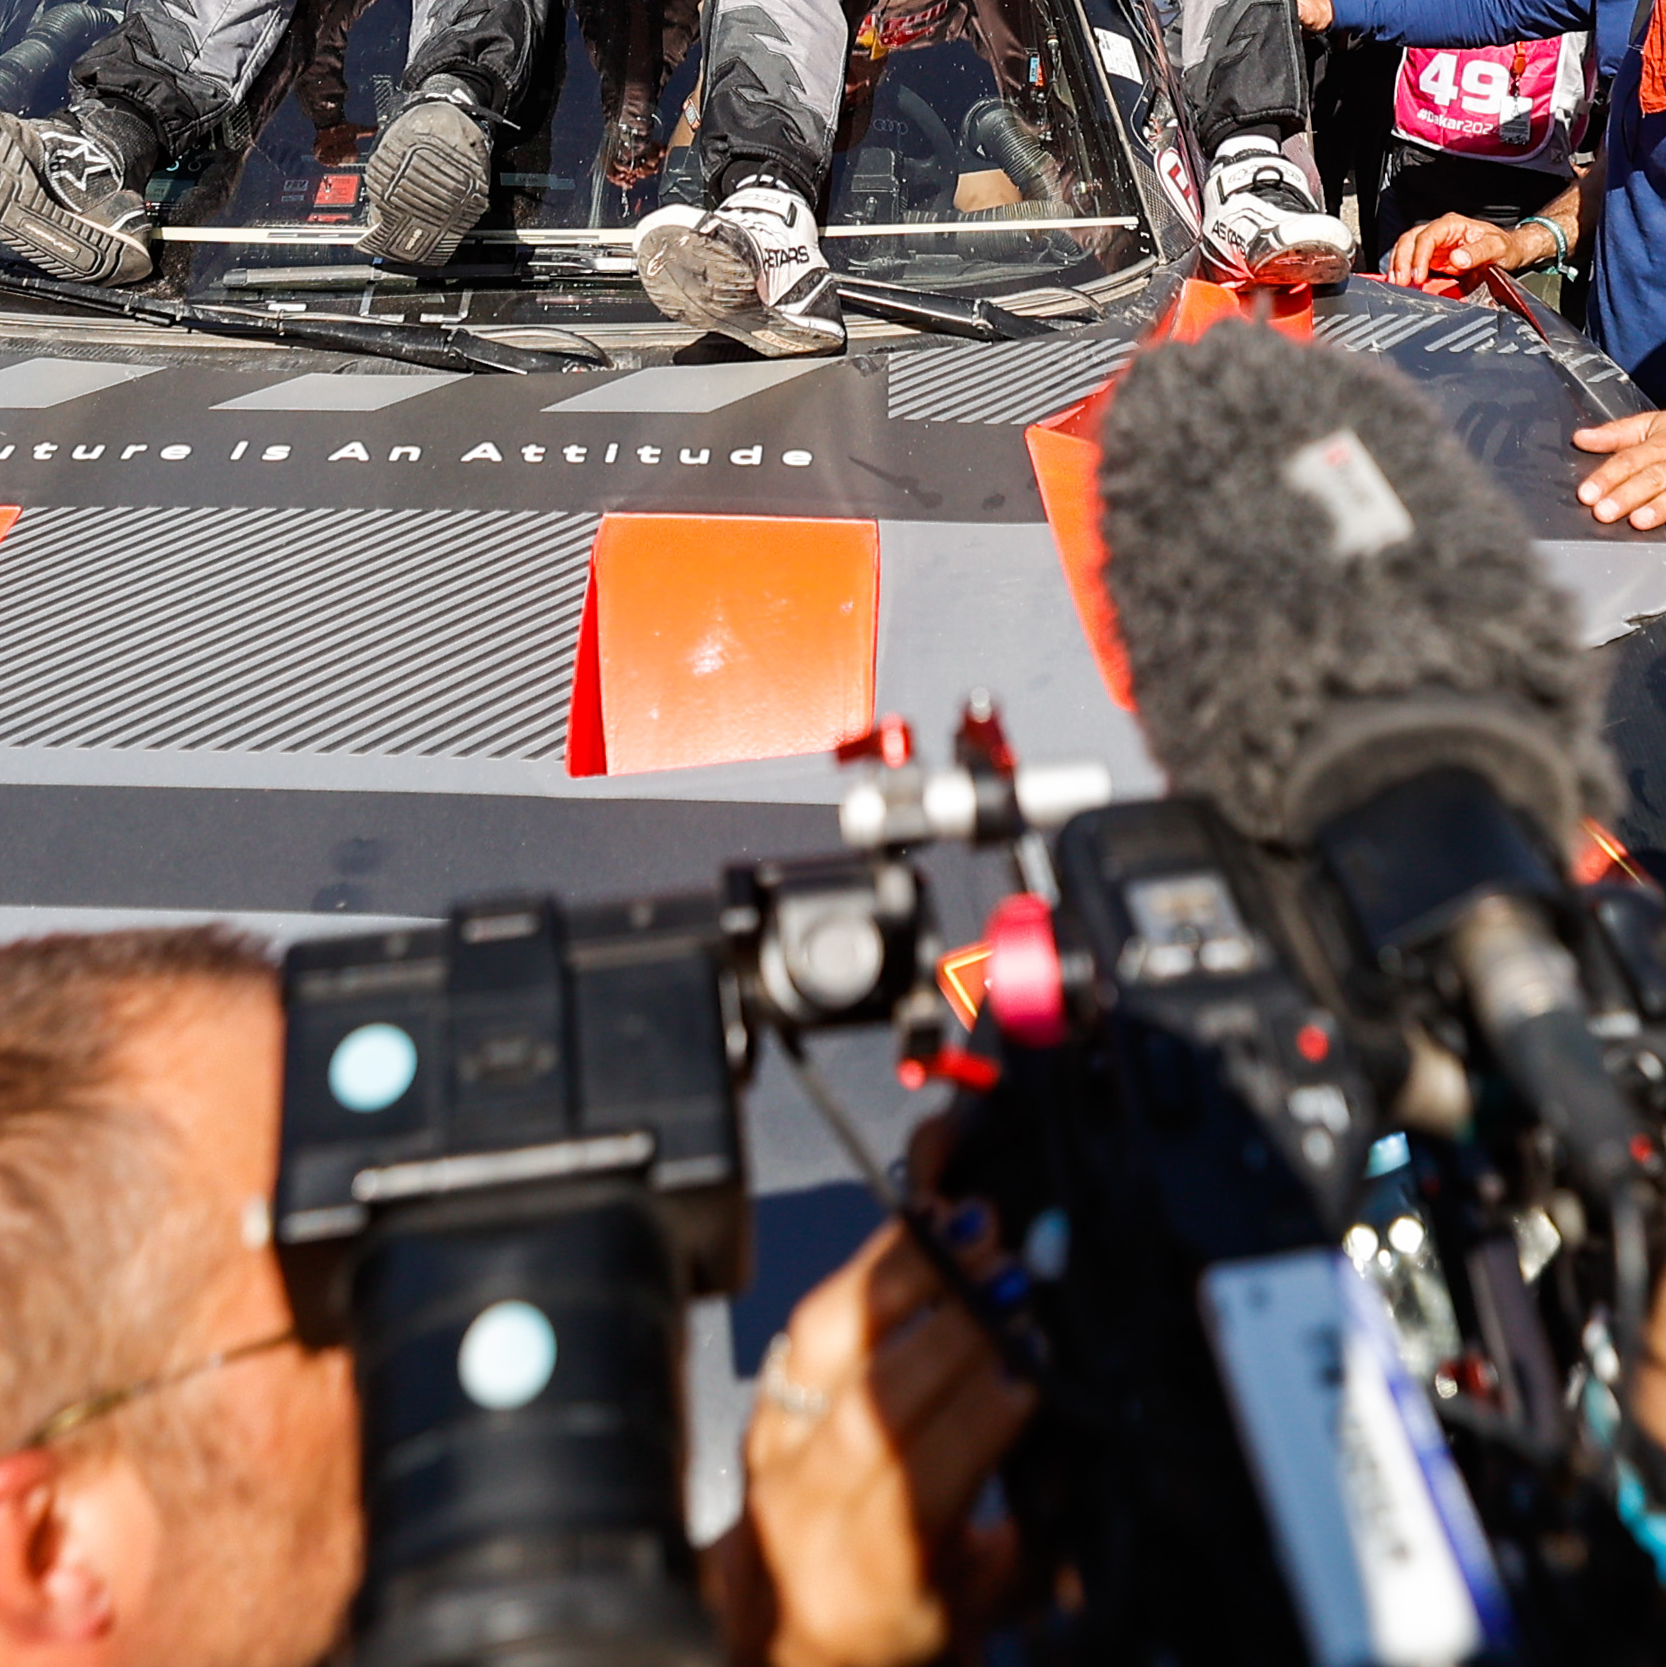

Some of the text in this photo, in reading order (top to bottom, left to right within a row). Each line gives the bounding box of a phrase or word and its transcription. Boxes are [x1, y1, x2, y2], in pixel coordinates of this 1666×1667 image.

[1419, 52, 1512, 113] 49
[1417, 108, 1497, 134] #Dakar202
[230, 441, 291, 462] Is
[328, 441, 422, 463] An
[462, 442, 813, 467] Attitude
